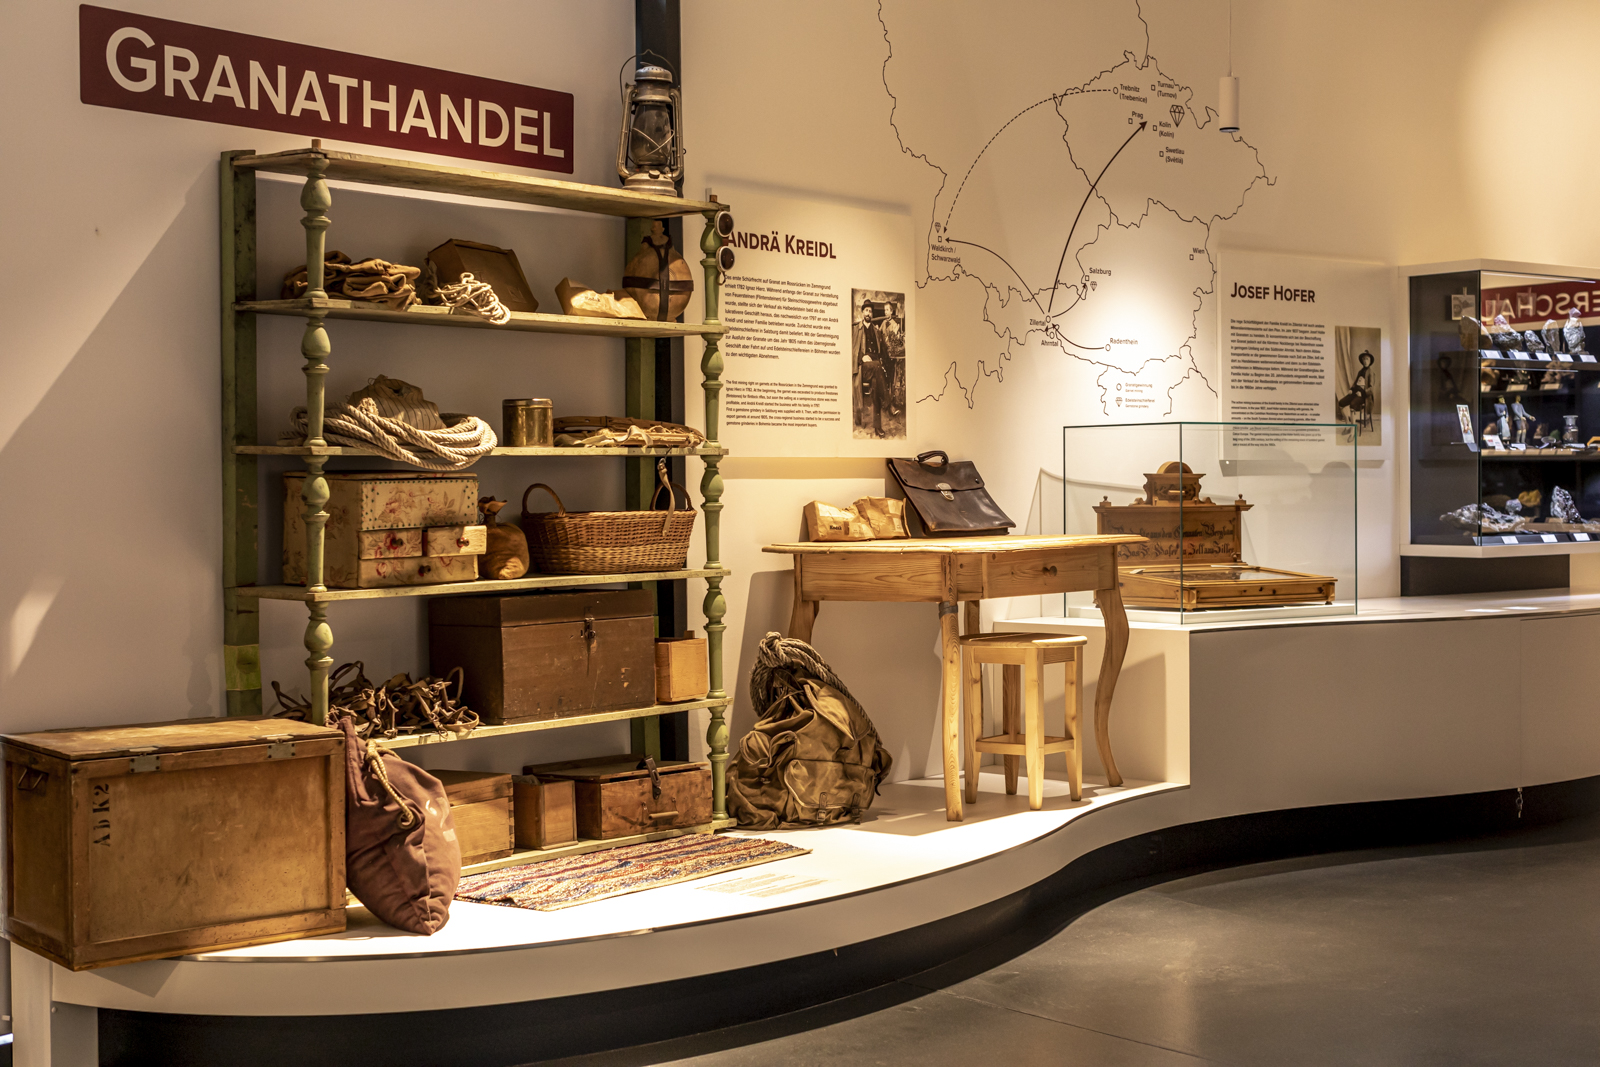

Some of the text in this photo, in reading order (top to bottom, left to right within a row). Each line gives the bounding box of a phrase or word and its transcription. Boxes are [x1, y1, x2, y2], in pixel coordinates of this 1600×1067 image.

[1120, 84, 1140, 92] Trebnitz
[1158, 81, 1174, 89] Turnau
[105, 26, 565, 159] GRANATHANDEL
[1157, 91, 1177, 99] (Turnov)
[1132, 111, 1143, 120] Prag
[728, 230, 836, 259] ANDRÄ KREIDL
[931, 244, 953, 254] Waldkirch
[931, 254, 961, 263] Schwarzwald
[1089, 267, 1112, 276] Salzburg
[1231, 282, 1316, 303] JOSEF HOFER
